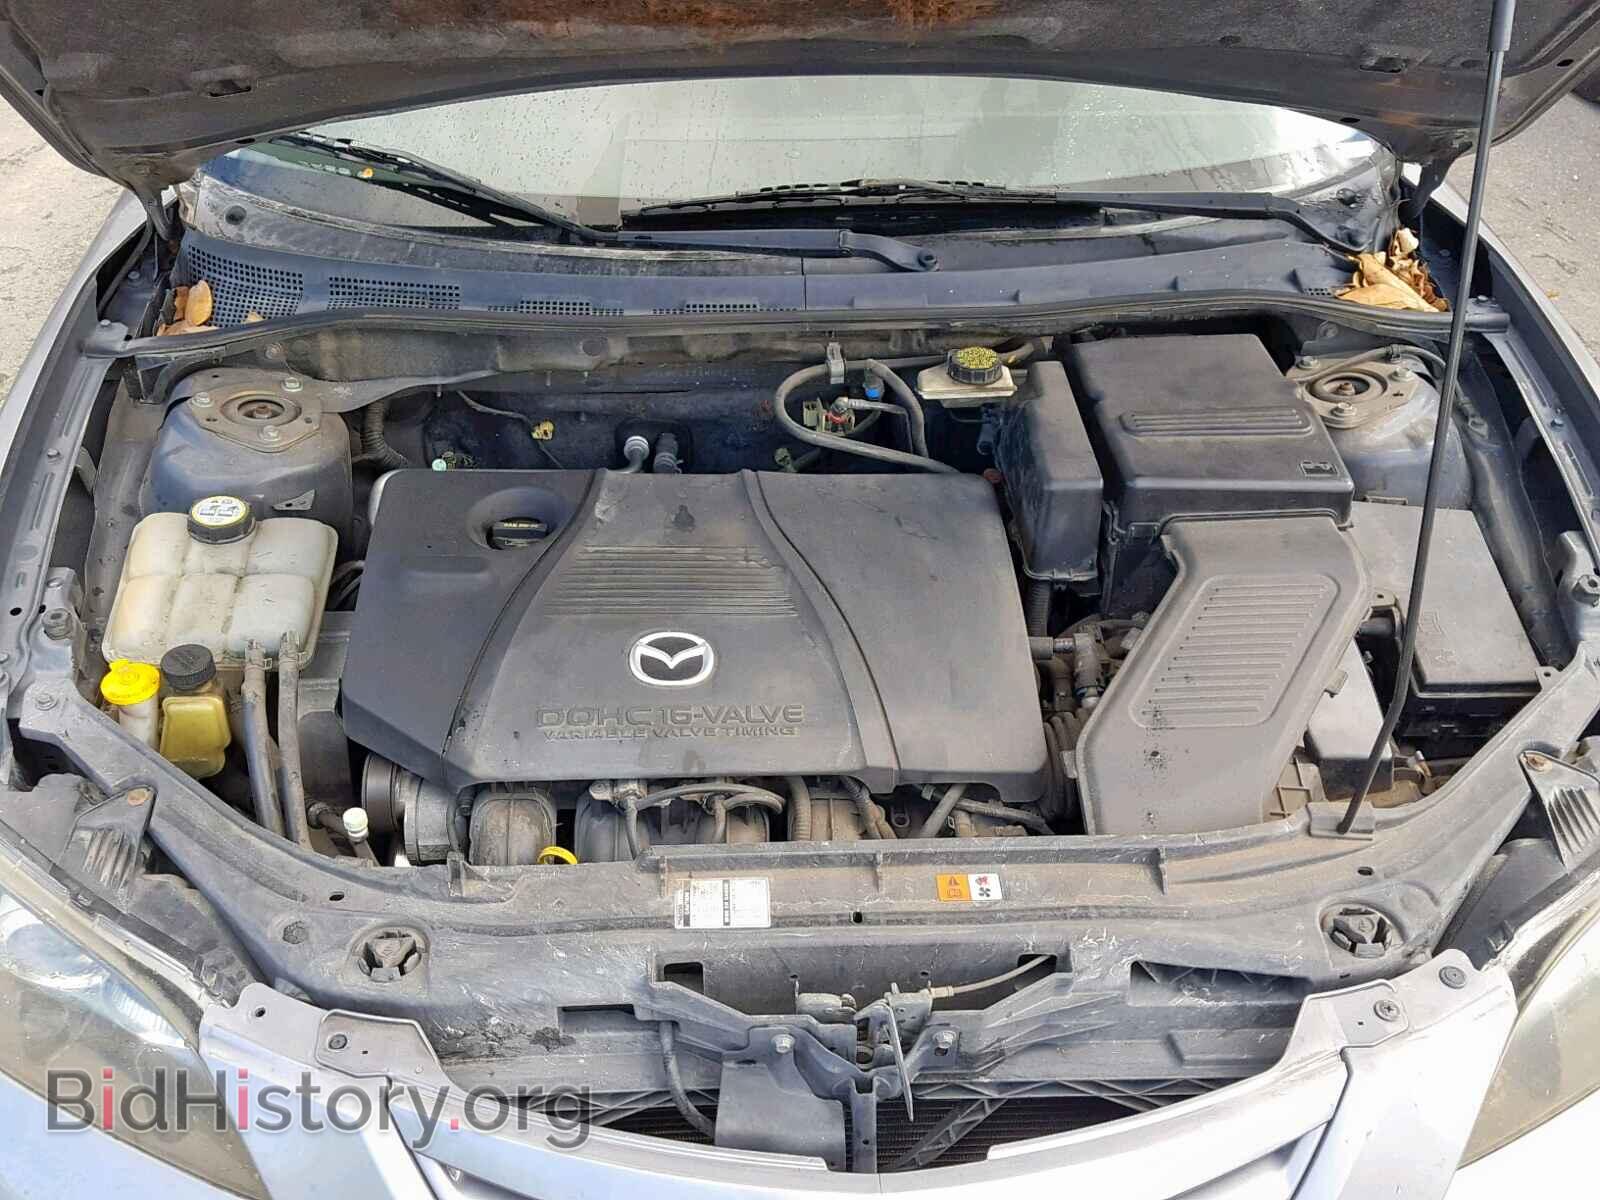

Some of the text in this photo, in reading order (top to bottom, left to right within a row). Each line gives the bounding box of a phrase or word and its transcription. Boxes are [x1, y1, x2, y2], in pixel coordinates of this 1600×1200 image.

[536, 704, 804, 727] DOHC 16-VALVE
[544, 726, 796, 740] VARIABLE VALVE TIMING
